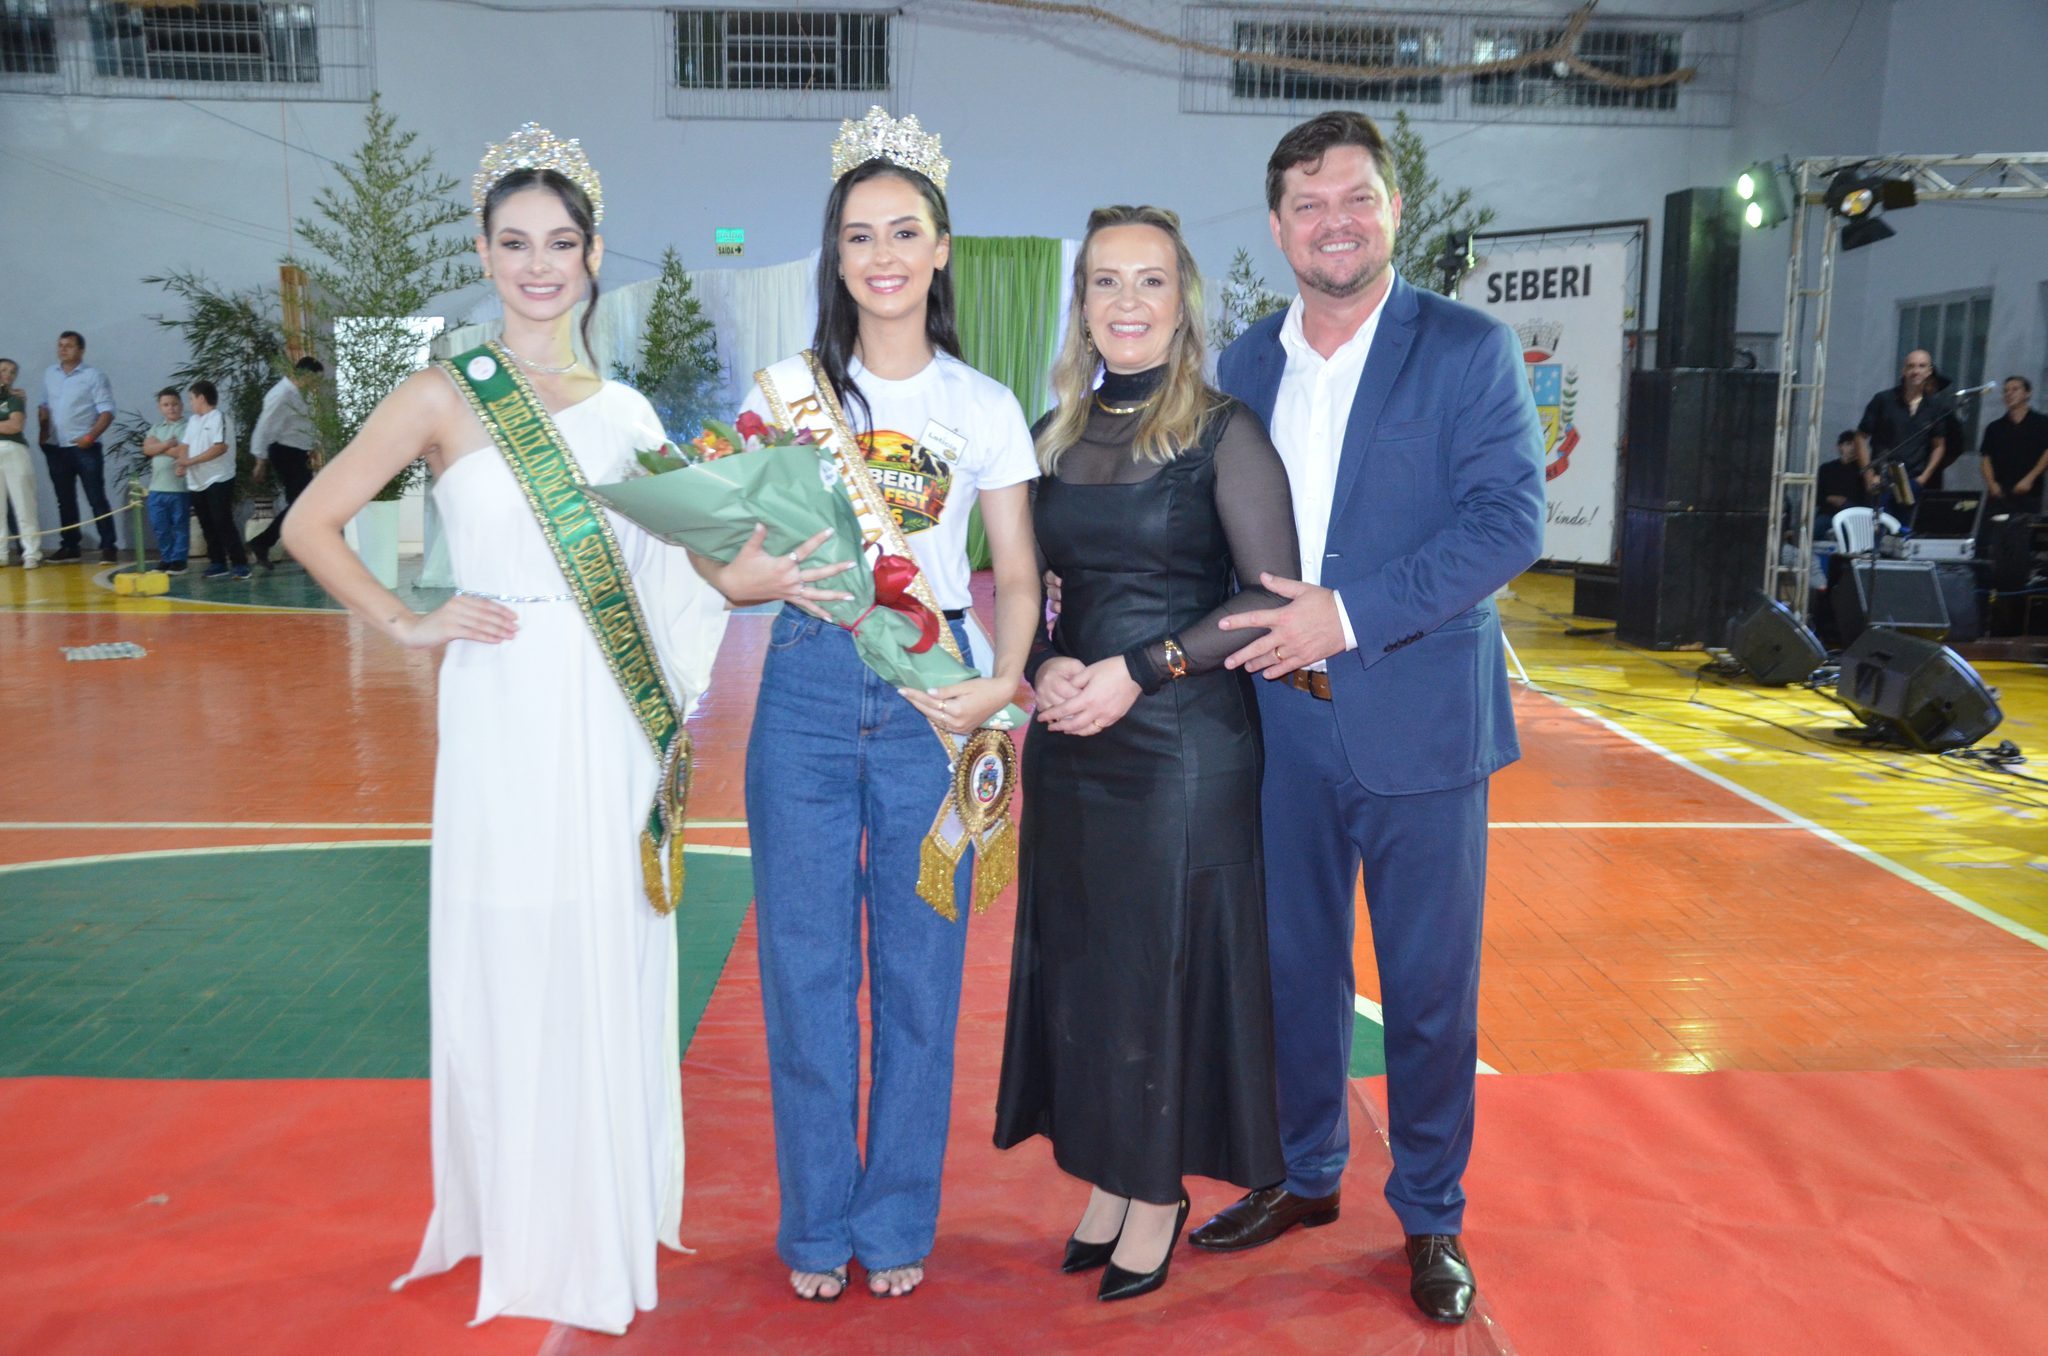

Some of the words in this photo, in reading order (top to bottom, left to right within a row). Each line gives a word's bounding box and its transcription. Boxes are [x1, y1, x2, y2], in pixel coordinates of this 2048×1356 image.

[1487, 263, 1592, 303] SEBERI
[487, 390, 579, 511] EMBAIXADORA
[868, 468, 923, 492] BERI
[884, 488, 929, 511] FEST
[1546, 501, 1600, 527] Vindo!
[554, 503, 592, 537] DA
[568, 534, 622, 605] SEBERI
